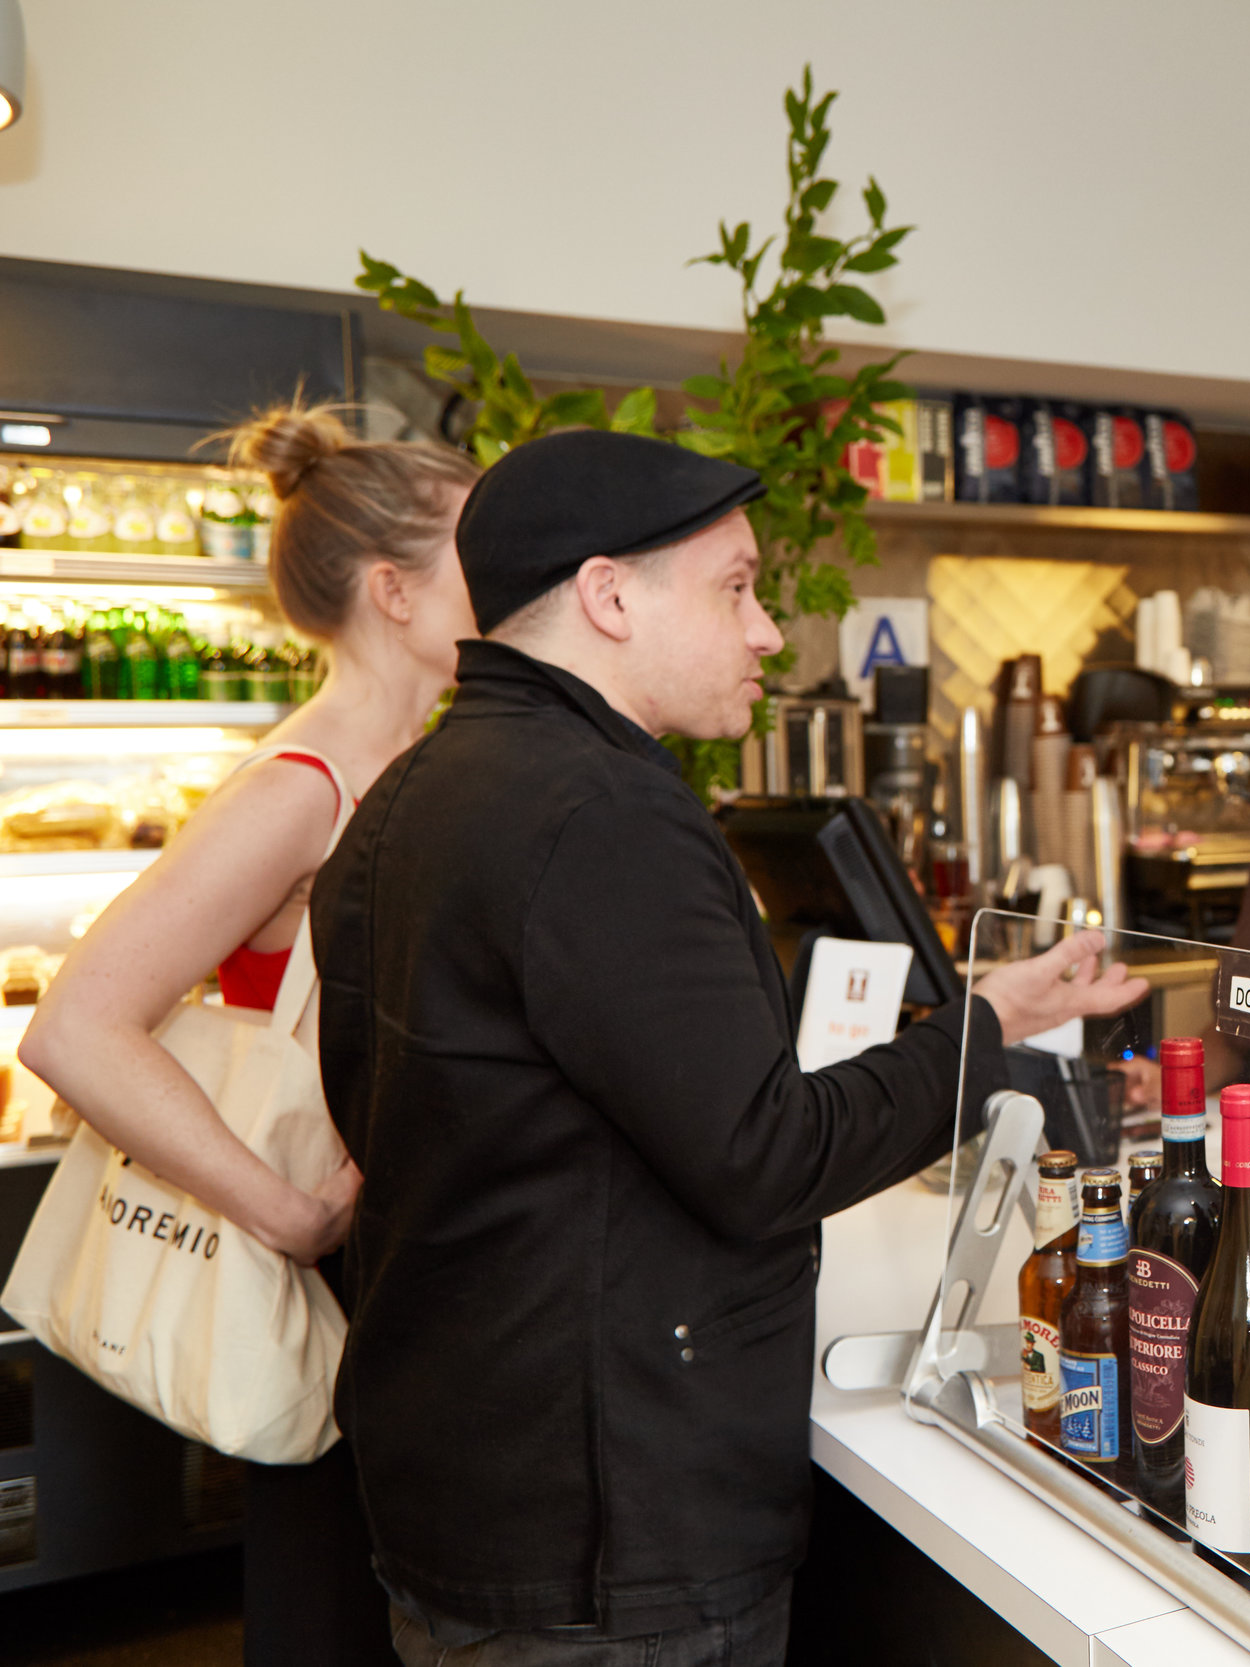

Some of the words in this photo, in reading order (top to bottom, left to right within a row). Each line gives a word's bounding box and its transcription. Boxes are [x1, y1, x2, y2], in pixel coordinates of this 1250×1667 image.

[860, 615, 906, 679] A
[1023, 1319, 1060, 1349] MORE
[1130, 1335, 1183, 1359] PERIORE
[1064, 1391, 1099, 1412] MOON
